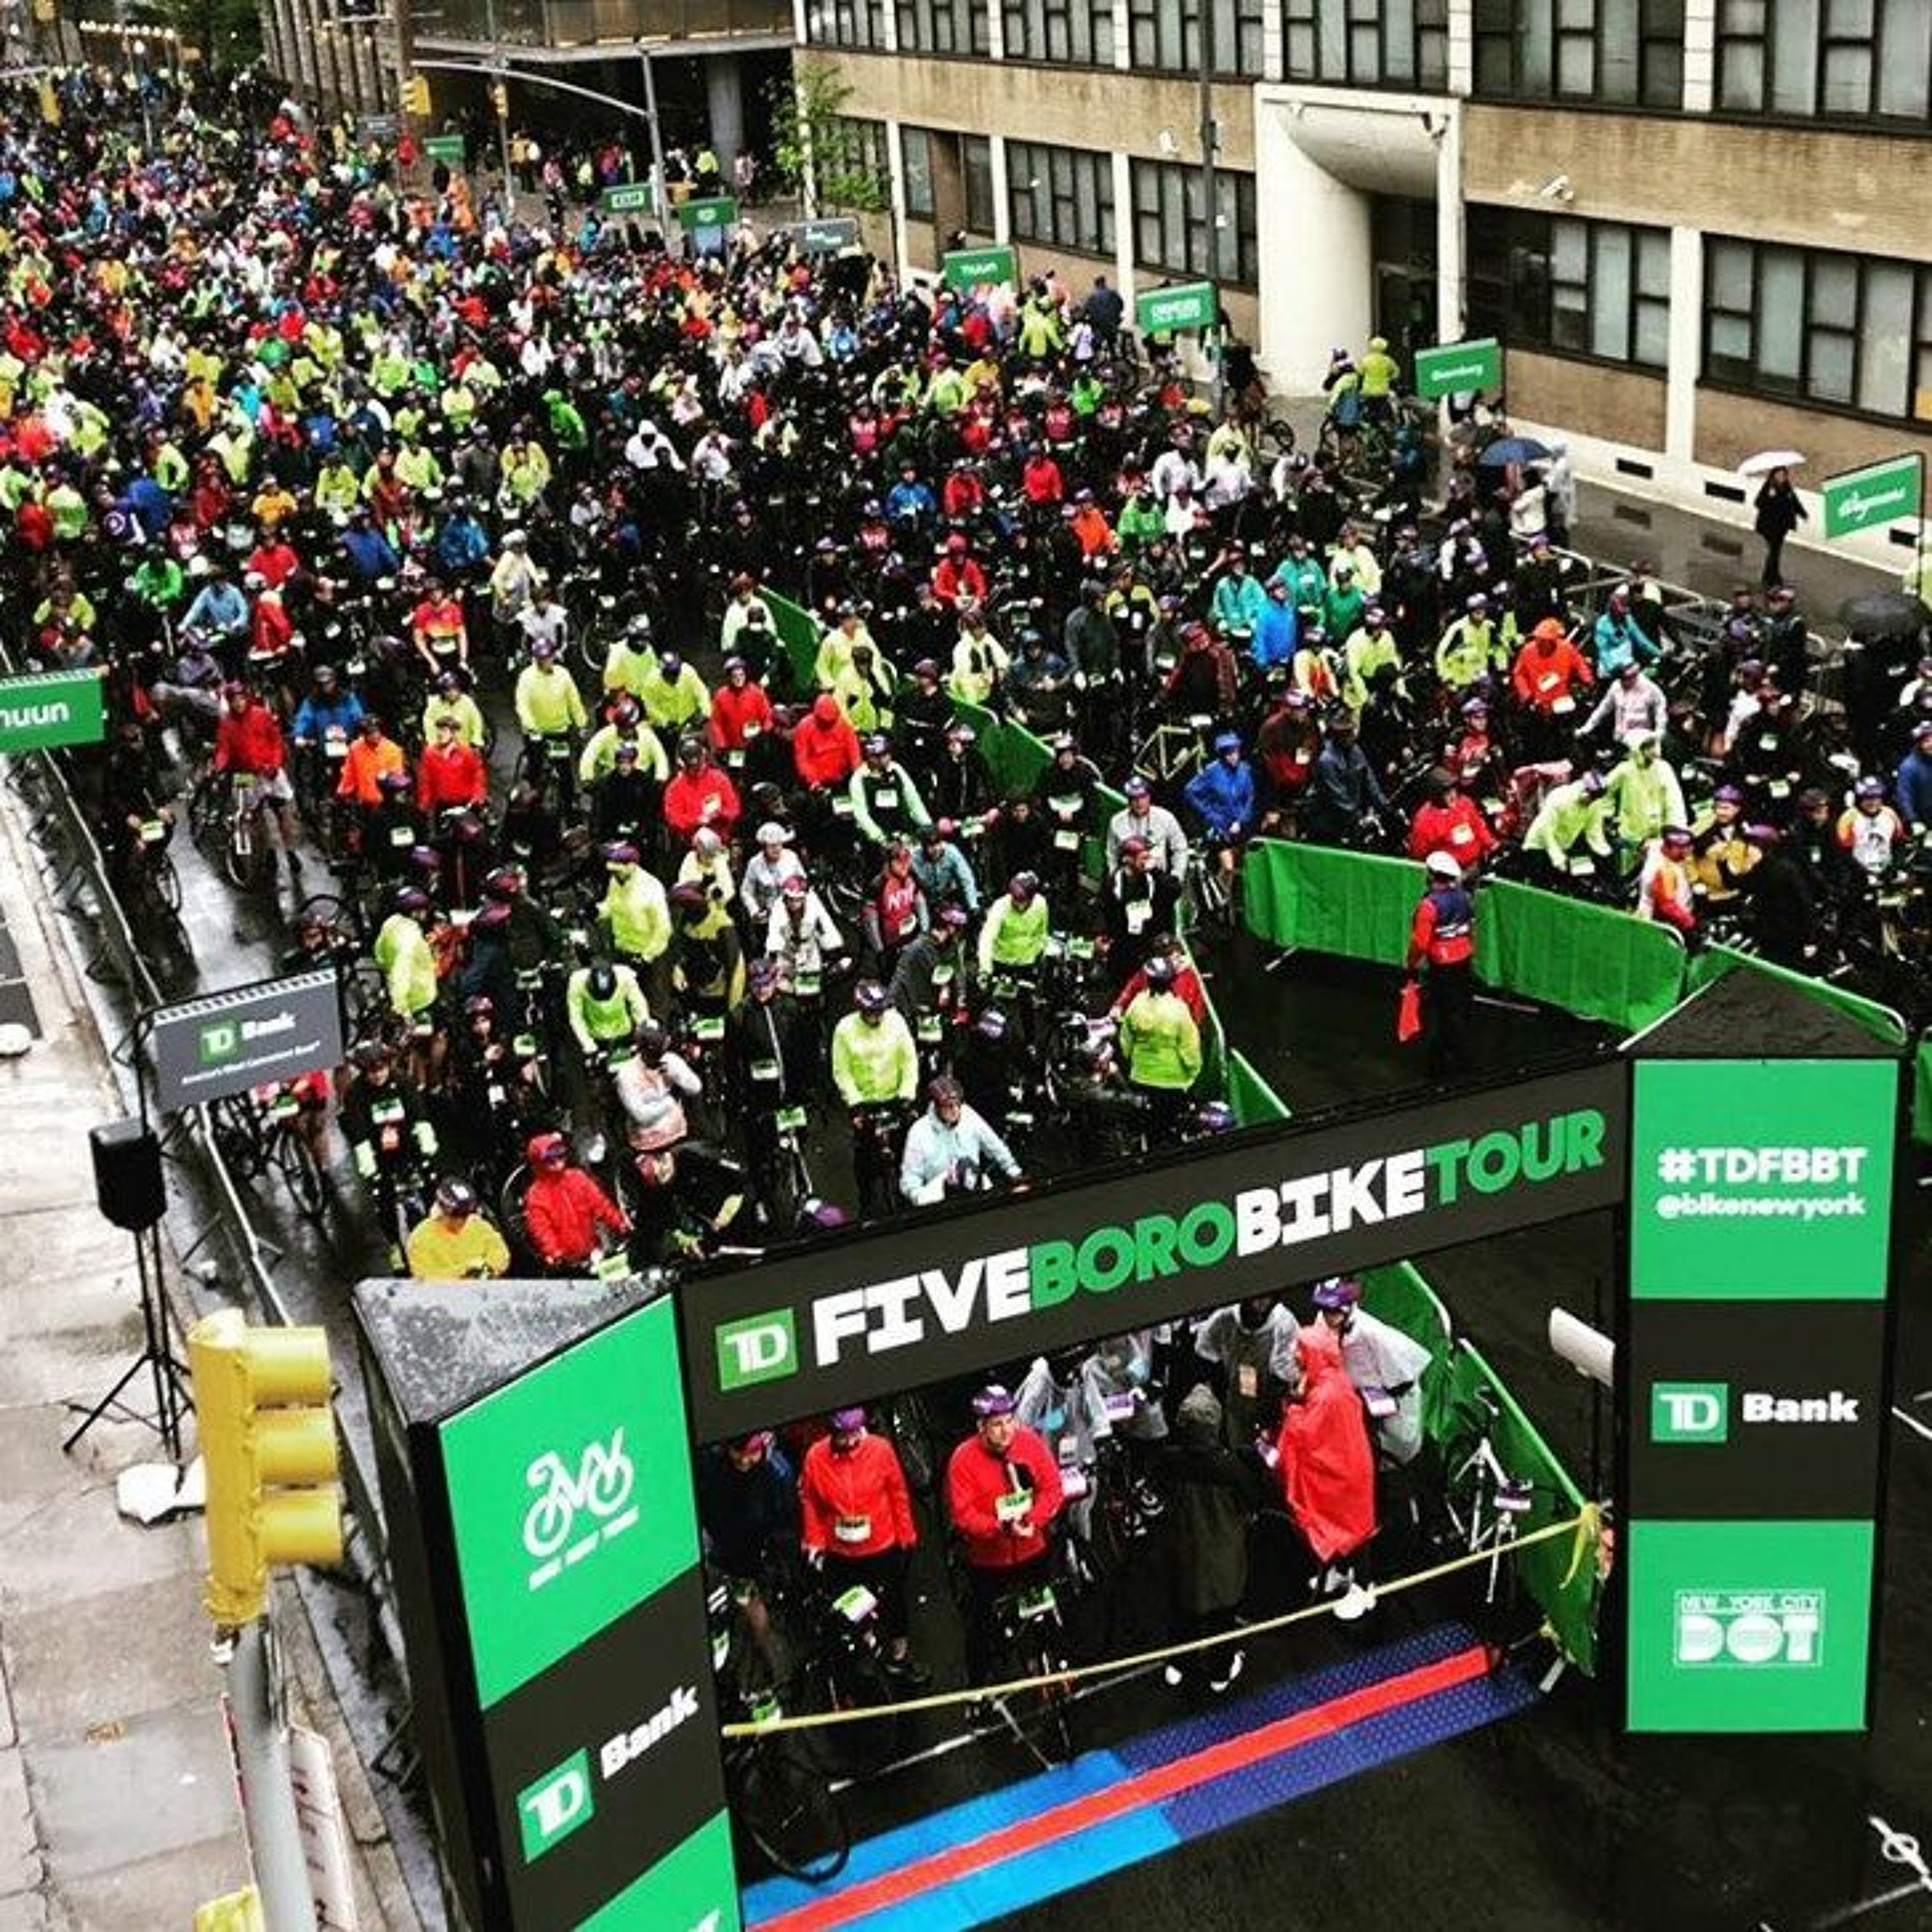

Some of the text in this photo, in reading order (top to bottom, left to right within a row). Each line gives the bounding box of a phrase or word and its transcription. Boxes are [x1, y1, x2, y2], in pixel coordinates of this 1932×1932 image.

[202, 1012, 296, 1055] TD Bank
[1658, 1147, 1868, 1183] #TDFBBT
[1656, 1192, 1866, 1220] @bikenewyork
[724, 1324, 790, 1374] TD
[1660, 1390, 1859, 1431] TD Bank
[1678, 1614, 1819, 1663] DOT
[525, 1686, 699, 1836] TD Bank
